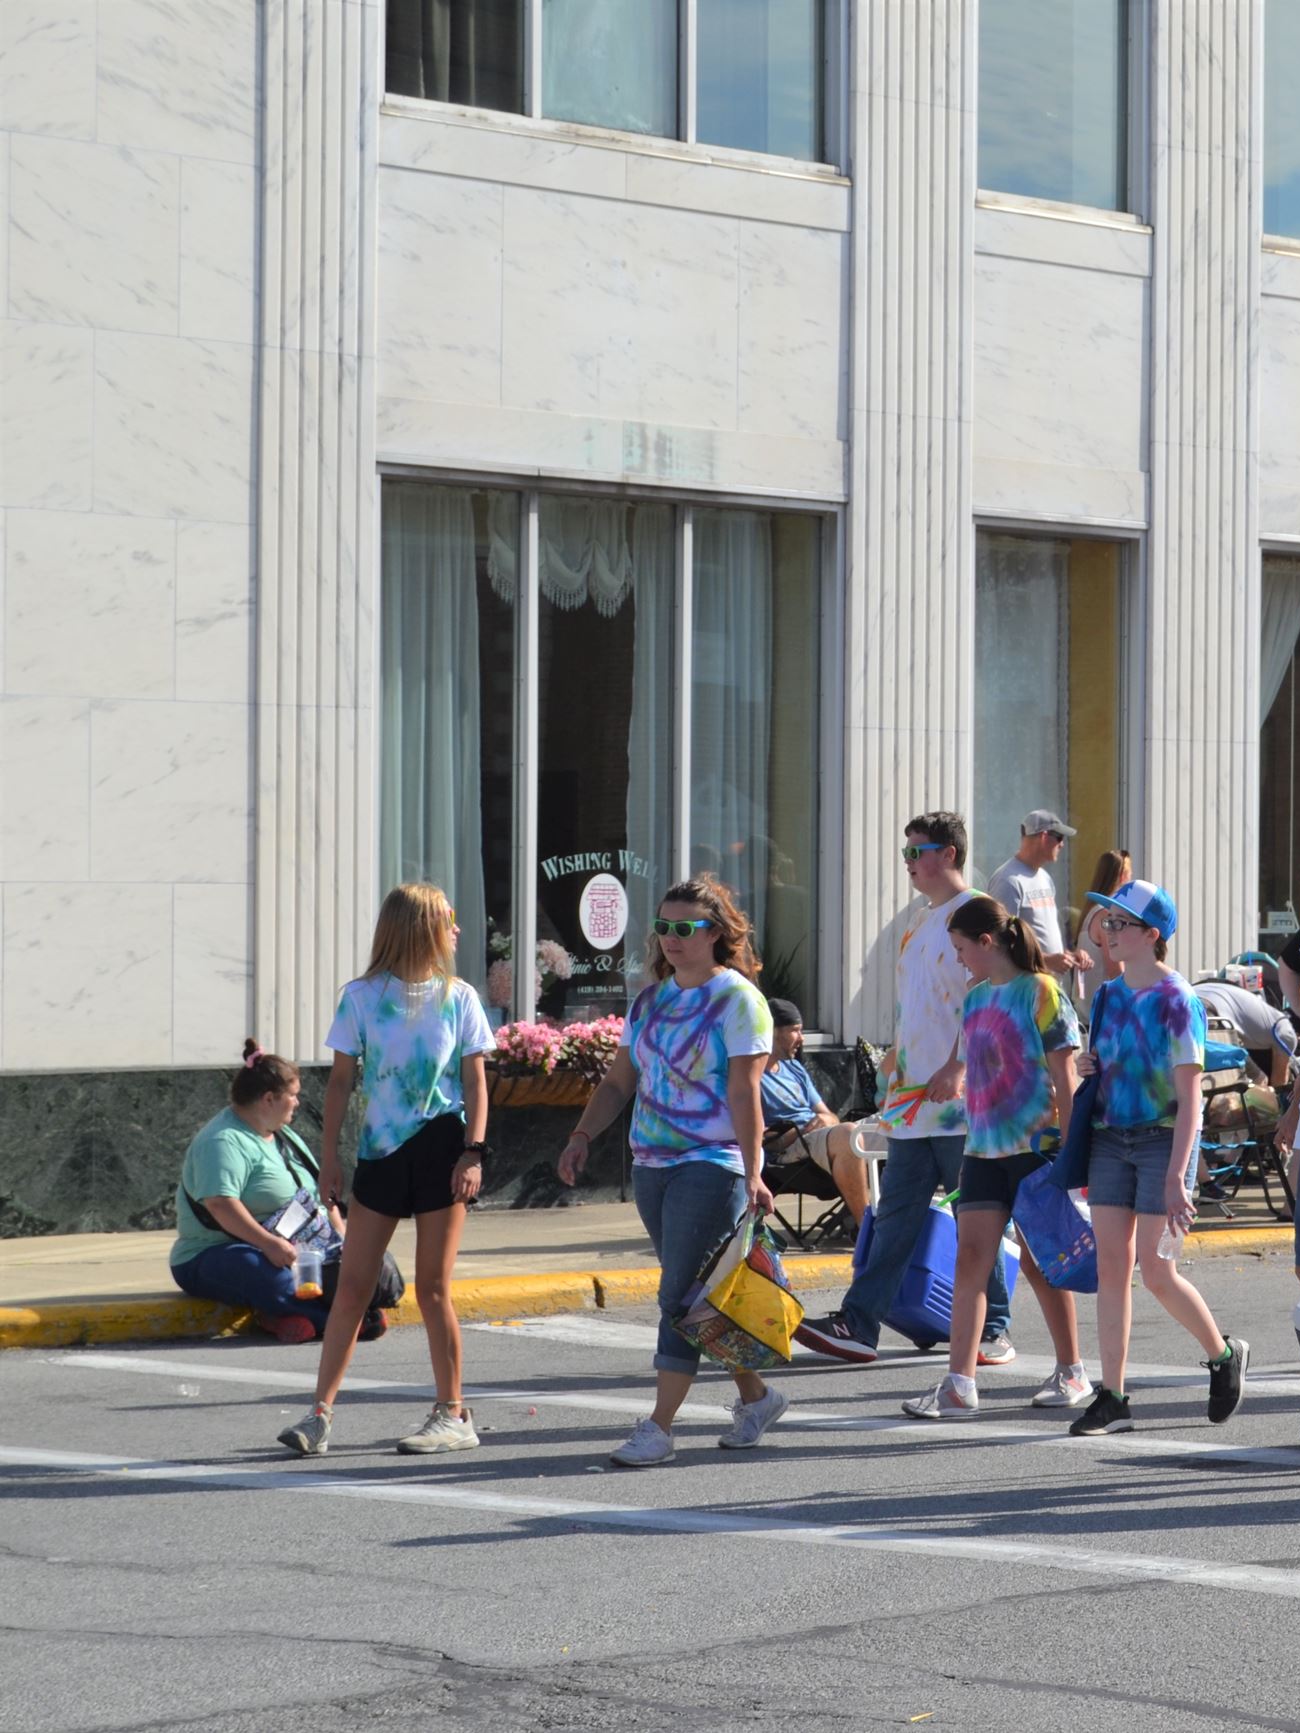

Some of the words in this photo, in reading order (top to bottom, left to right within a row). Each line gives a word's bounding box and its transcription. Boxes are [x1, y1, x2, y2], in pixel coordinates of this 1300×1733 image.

[568, 952, 592, 975] linic
[594, 954, 613, 972] &
[832, 1323, 850, 1337] N
